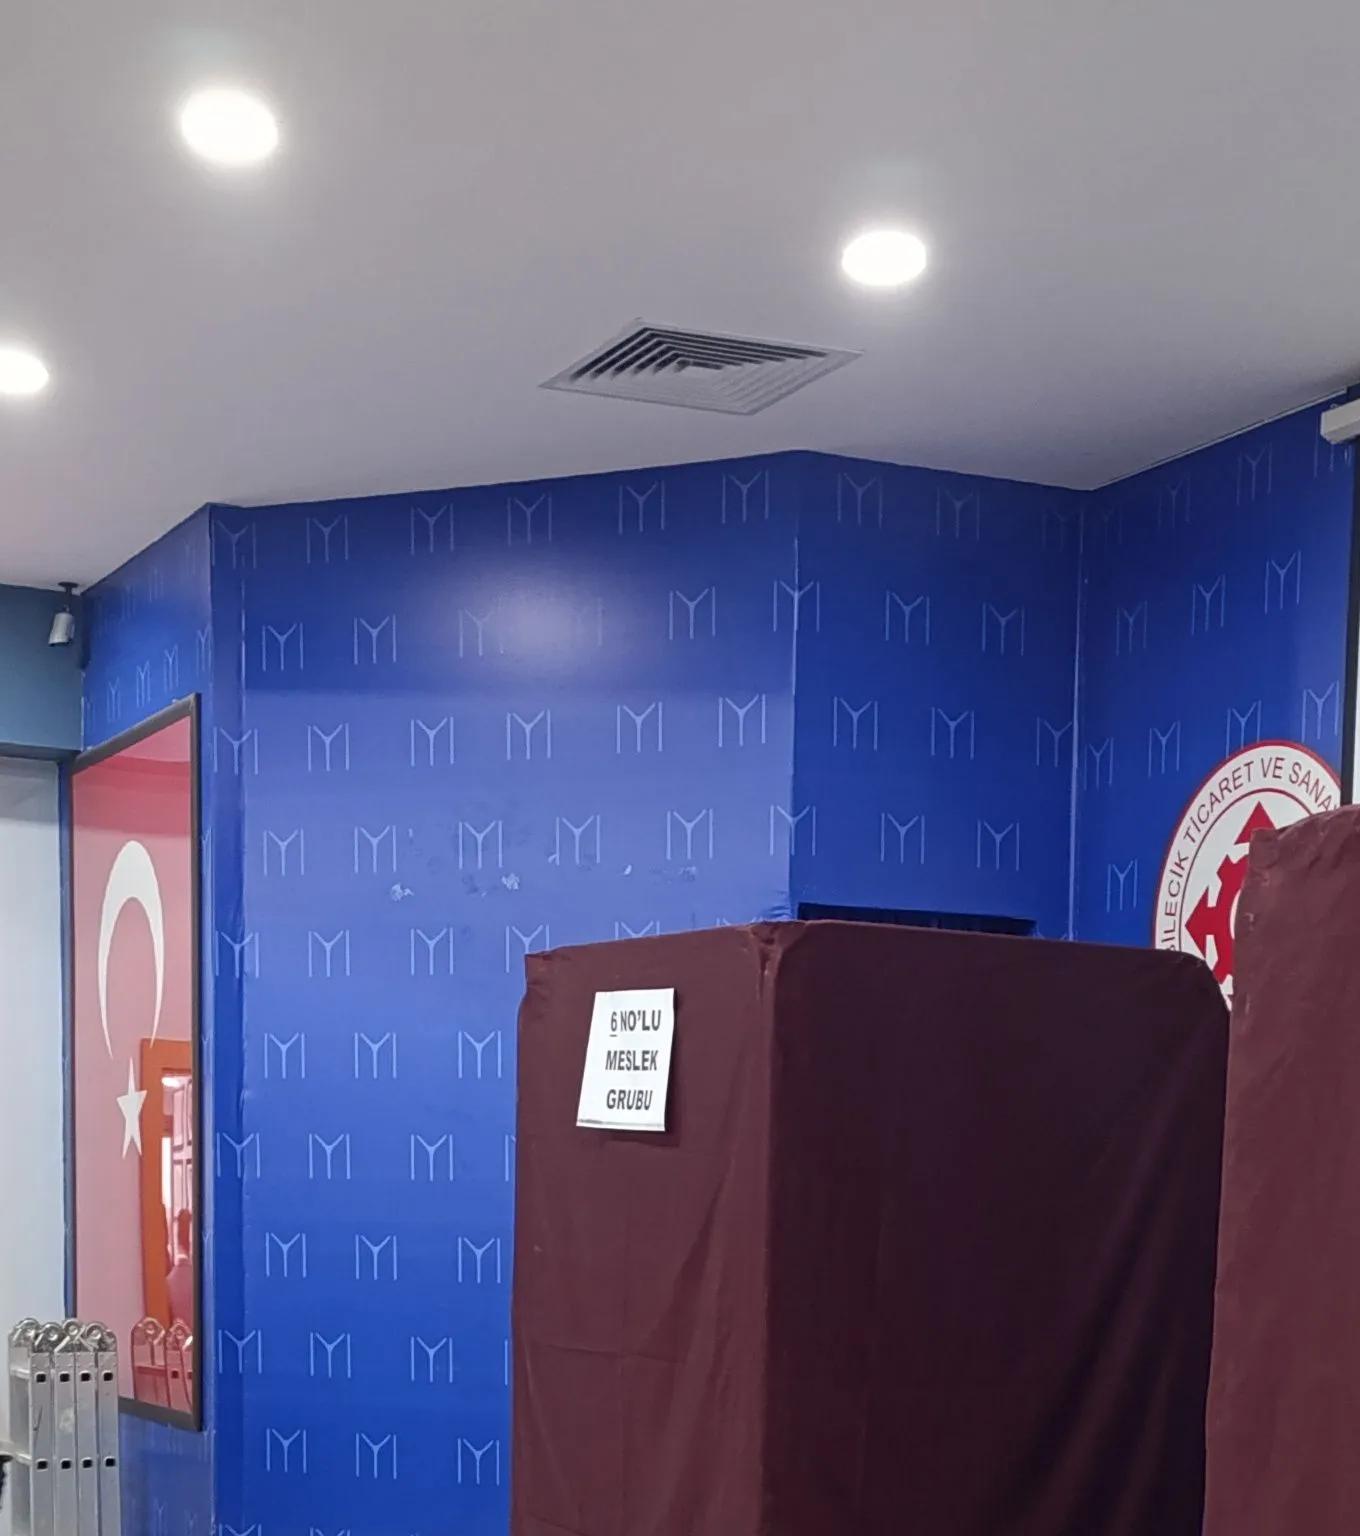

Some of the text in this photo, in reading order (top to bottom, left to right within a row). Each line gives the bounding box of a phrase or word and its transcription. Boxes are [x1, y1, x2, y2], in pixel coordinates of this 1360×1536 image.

[1261, 757, 1285, 779] VE
[1289, 762, 1338, 811] SANA
[610, 1010, 661, 1032] 6 NO'LU
[605, 1050, 658, 1071] MESLEK
[606, 1089, 653, 1110] GRUBU
